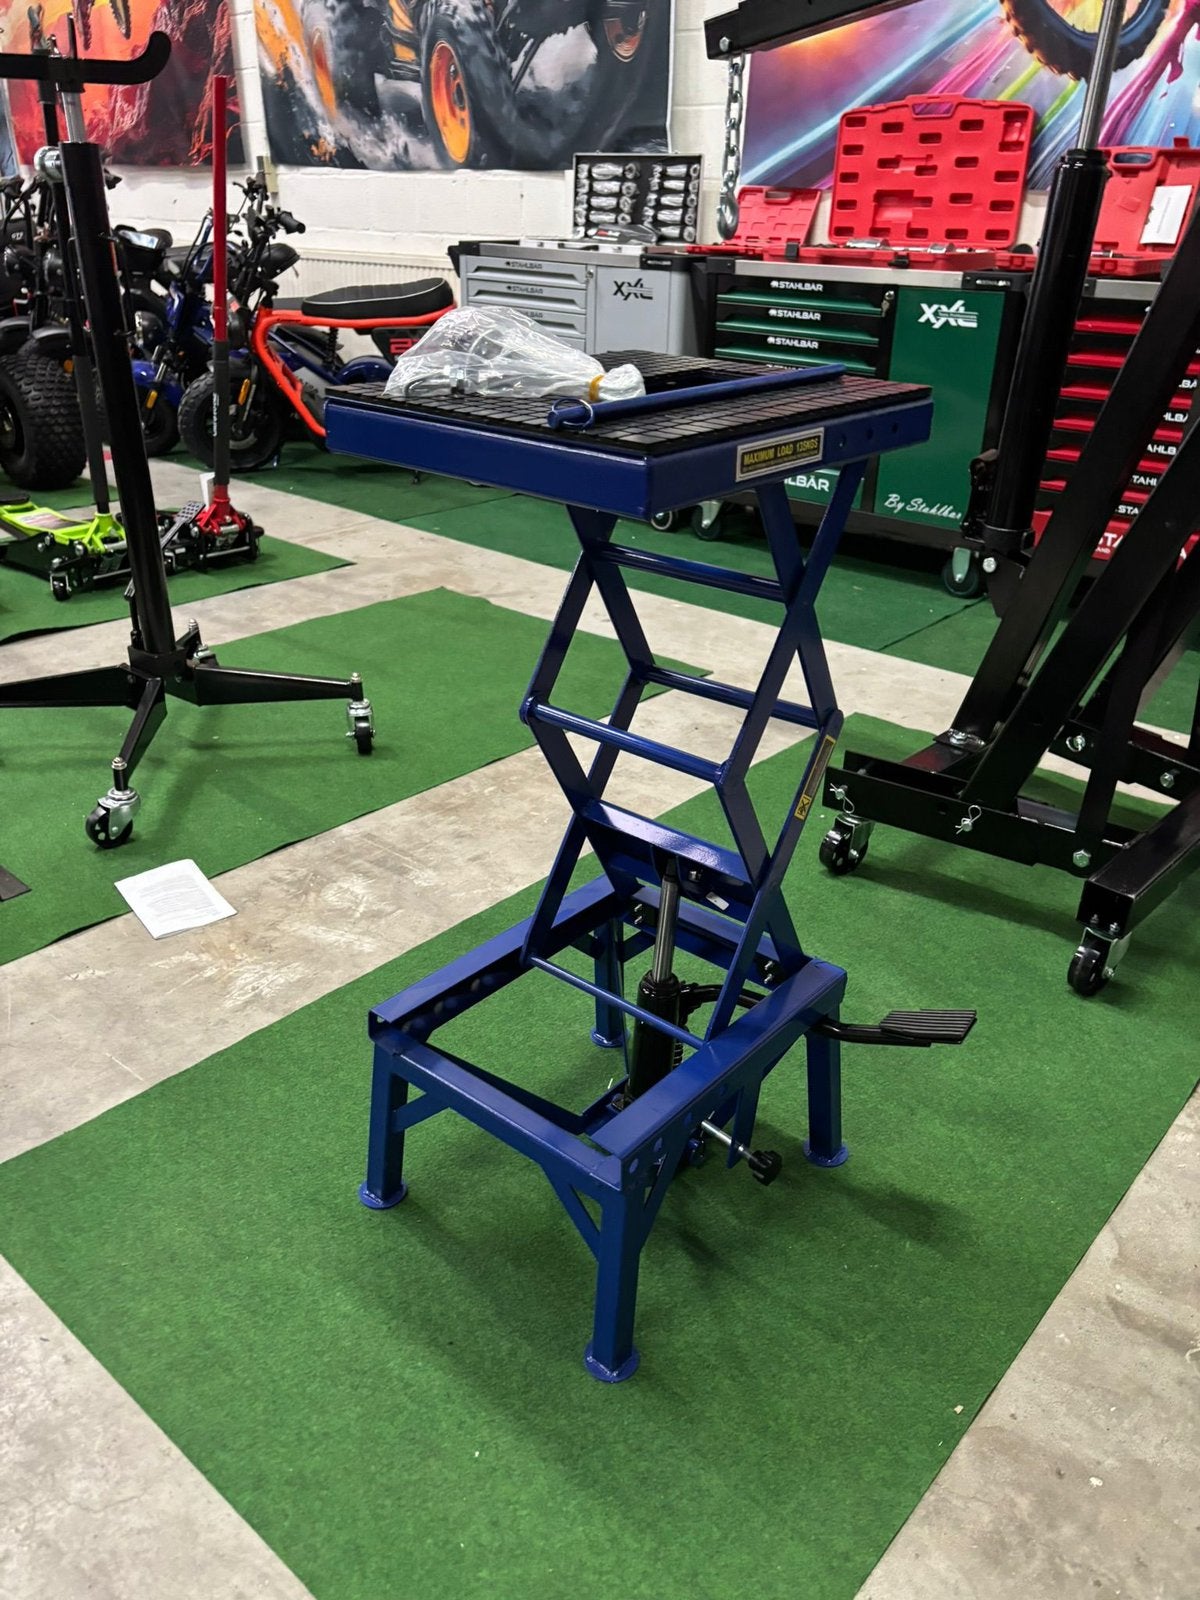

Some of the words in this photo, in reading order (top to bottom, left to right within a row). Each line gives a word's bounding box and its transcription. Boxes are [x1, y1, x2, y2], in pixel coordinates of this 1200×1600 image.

[613, 278, 653, 300] XXL
[918, 300, 978, 329] XXL
[743, 447, 775, 466] MAXIMUM
[777, 443, 794, 458] LOAD
[884, 494, 904, 513] By
